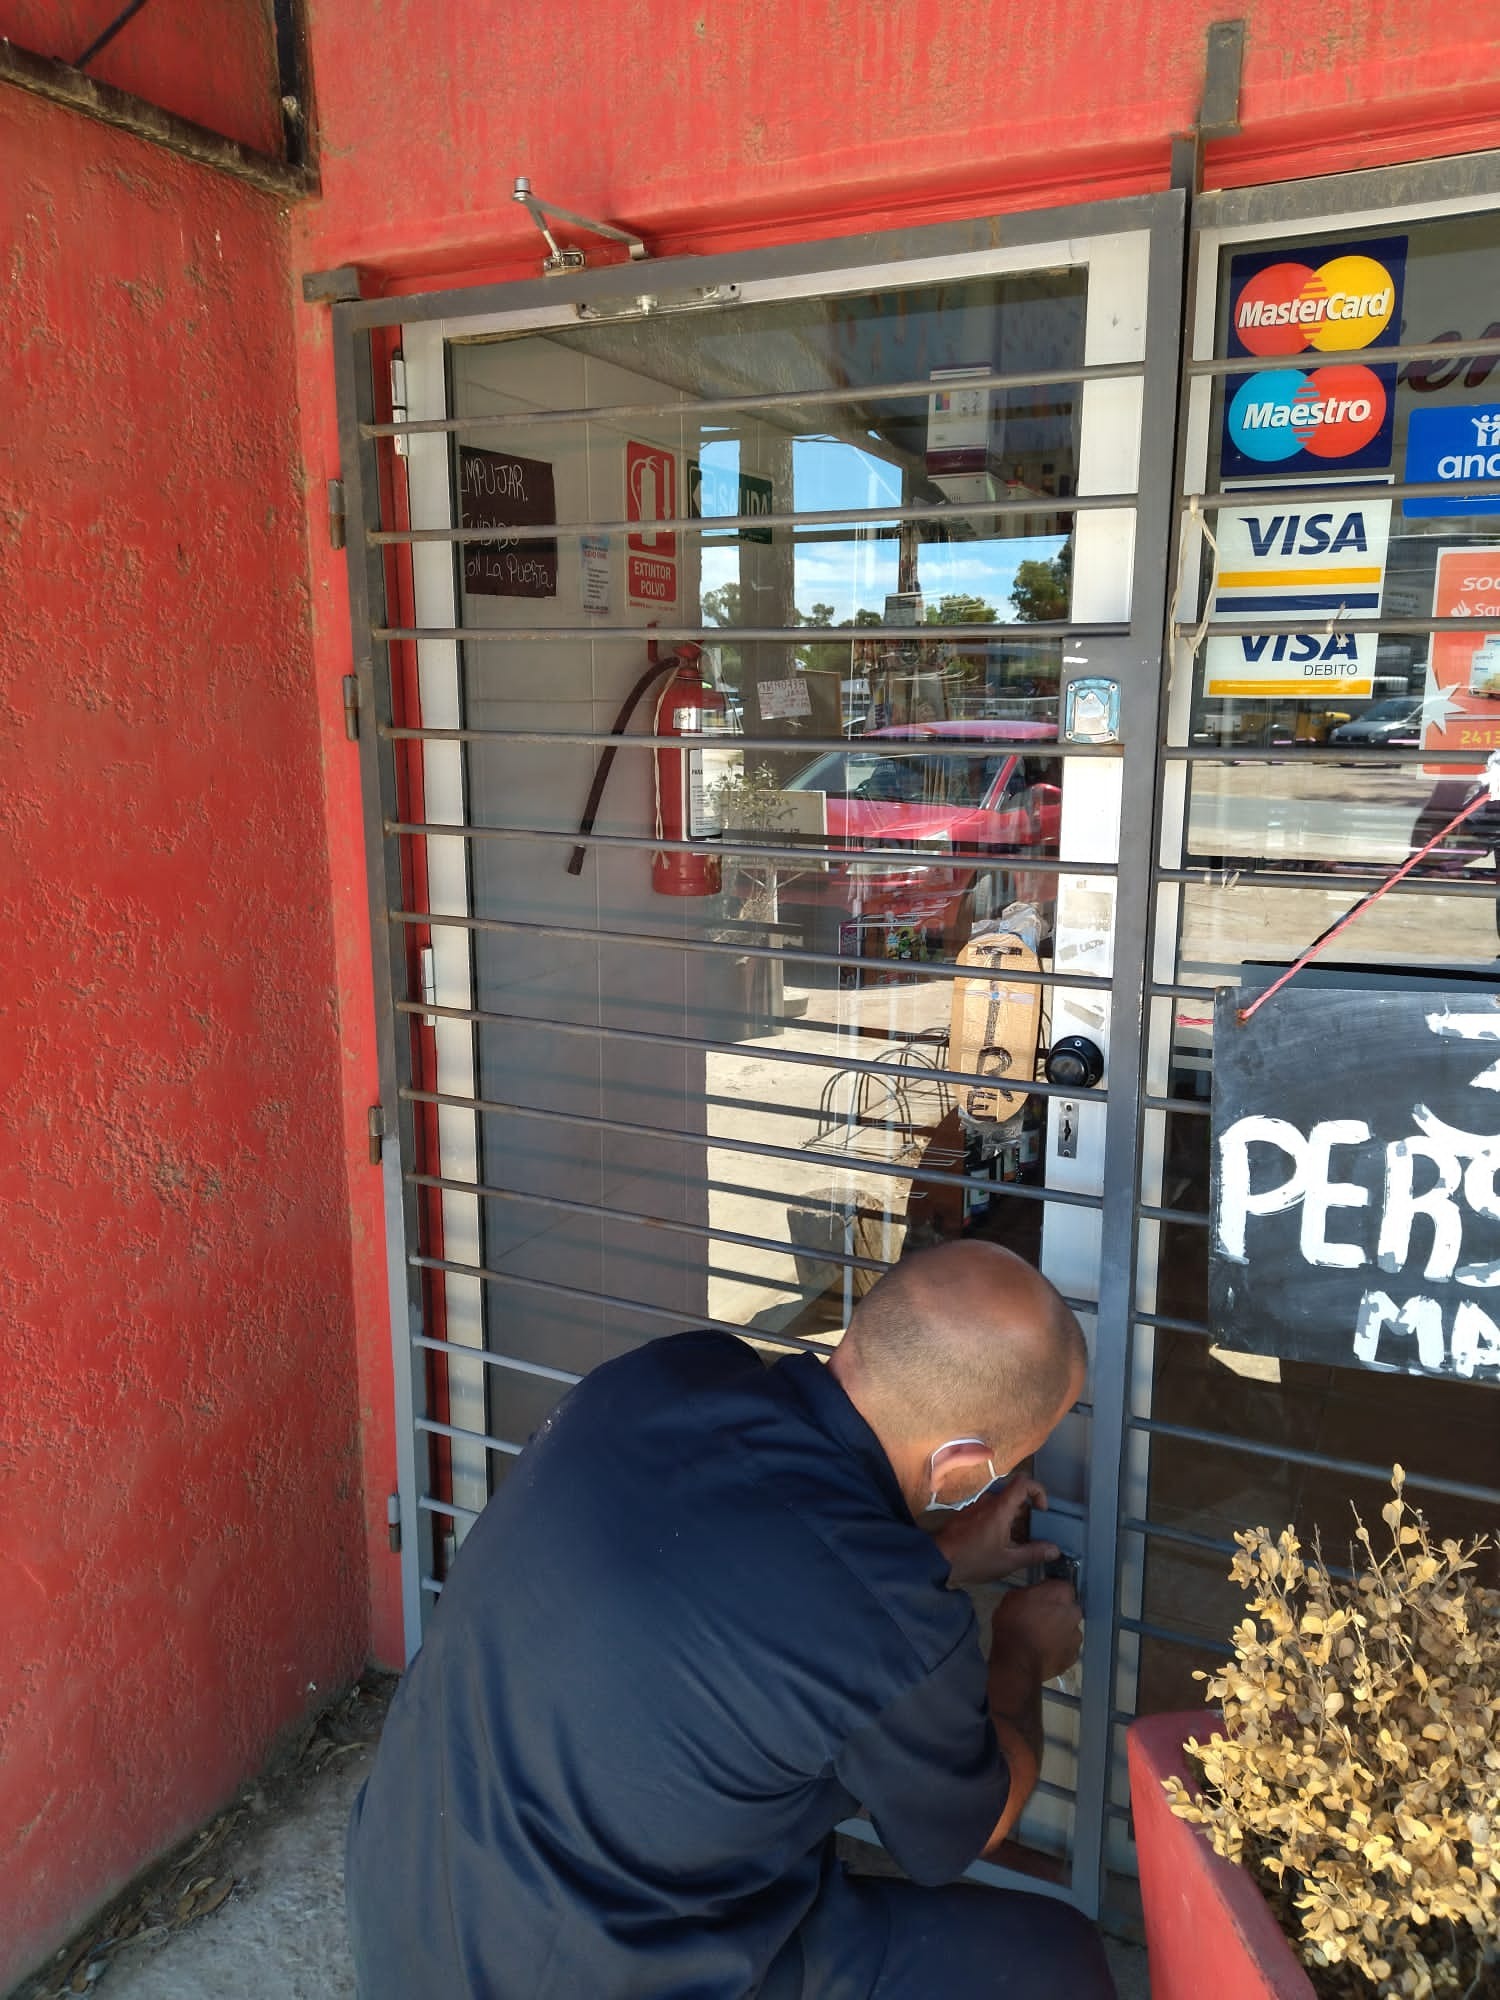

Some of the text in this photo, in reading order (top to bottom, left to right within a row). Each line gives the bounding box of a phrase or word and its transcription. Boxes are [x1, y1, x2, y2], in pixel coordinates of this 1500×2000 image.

[1237, 287, 1391, 329] MasterCard
[1241, 397, 1371, 431] Maestro
[1236, 511, 1369, 557] VISA
[634, 561, 671, 581] EXTINTOR
[640, 580, 666, 598] POLVO
[1240, 632, 1359, 662] VISA
[1304, 663, 1358, 676] DEBITO
